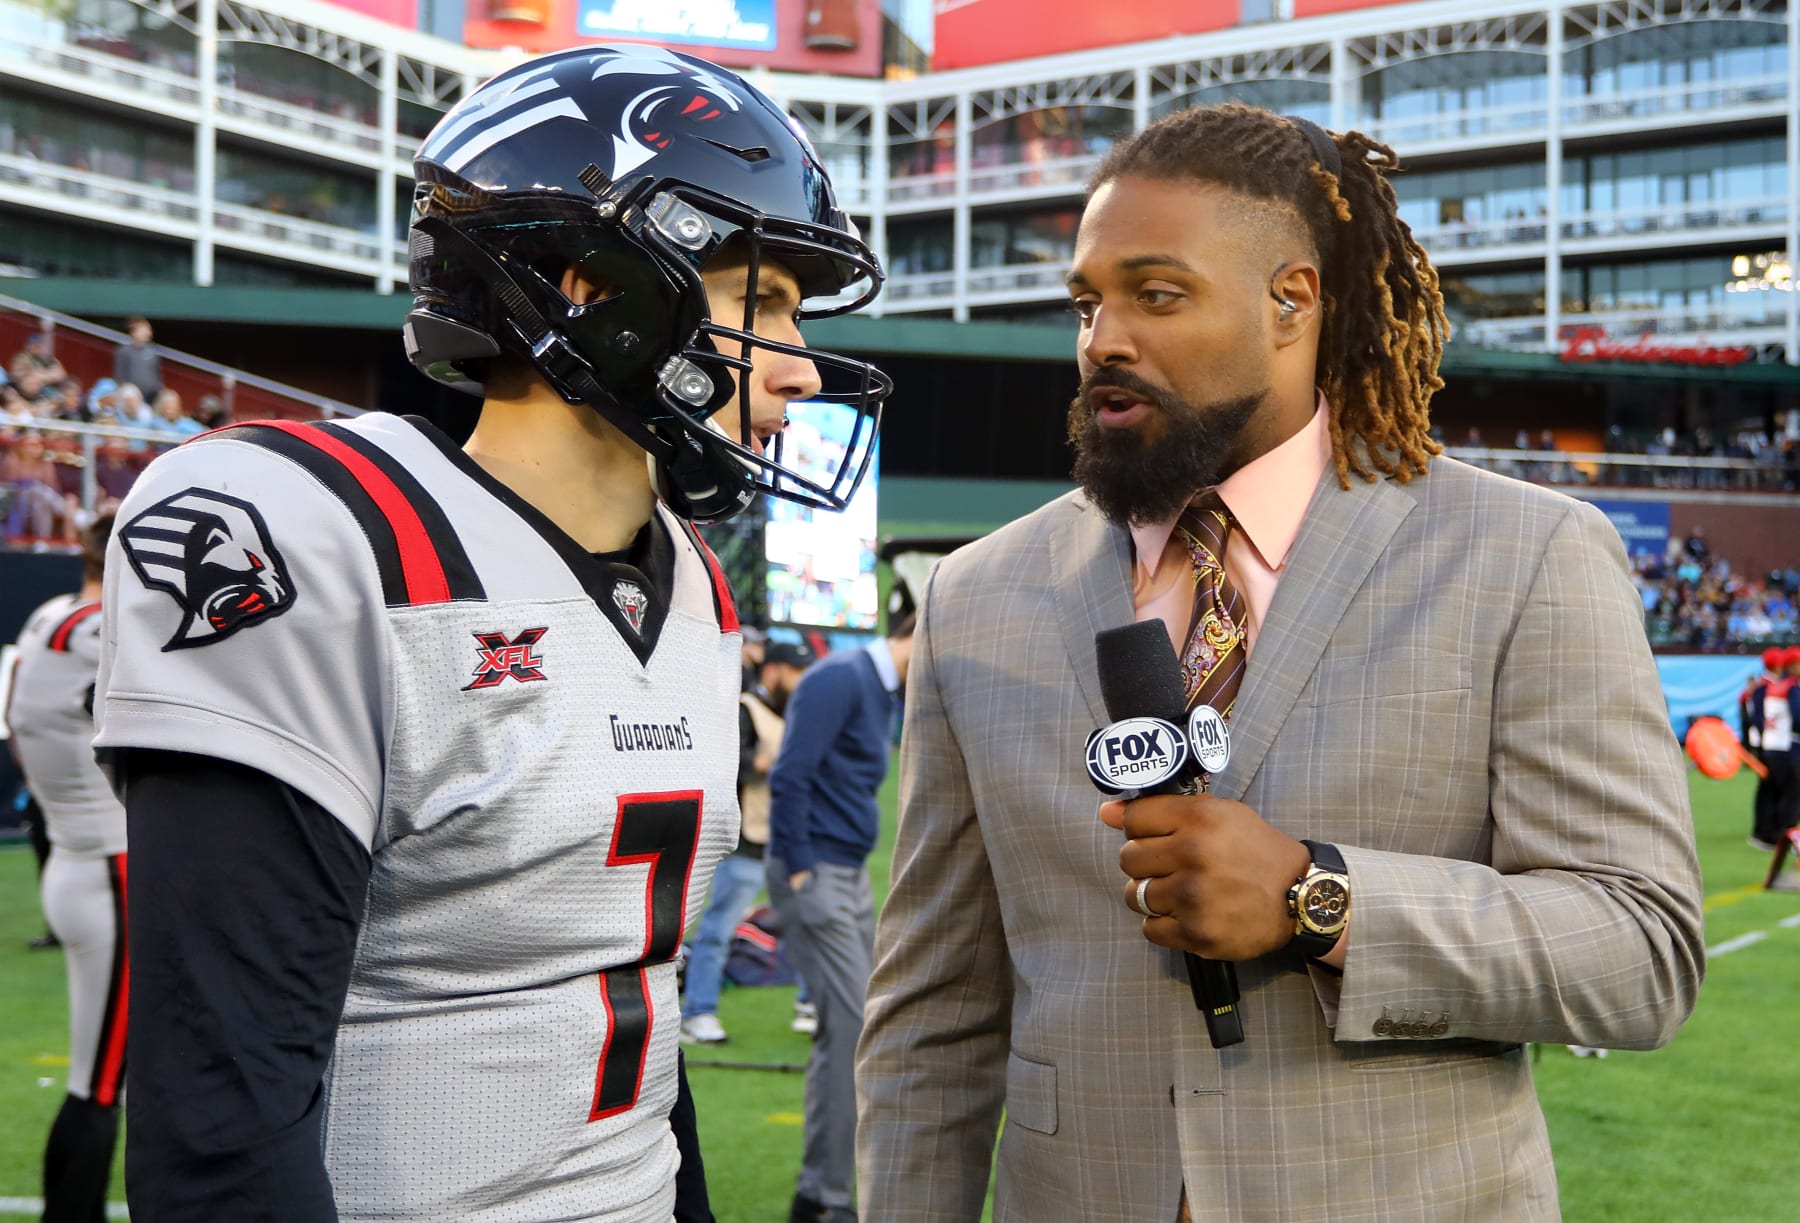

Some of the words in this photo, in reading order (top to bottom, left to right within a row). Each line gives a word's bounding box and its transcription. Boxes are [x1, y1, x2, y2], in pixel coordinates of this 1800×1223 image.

[472, 645, 543, 676] XFL
[1104, 728, 1166, 767] FOX
[1195, 718, 1223, 749] FOX
[1109, 756, 1170, 778] SPORTS
[1201, 745, 1226, 760] SPORTS
[588, 788, 705, 1124] 7
